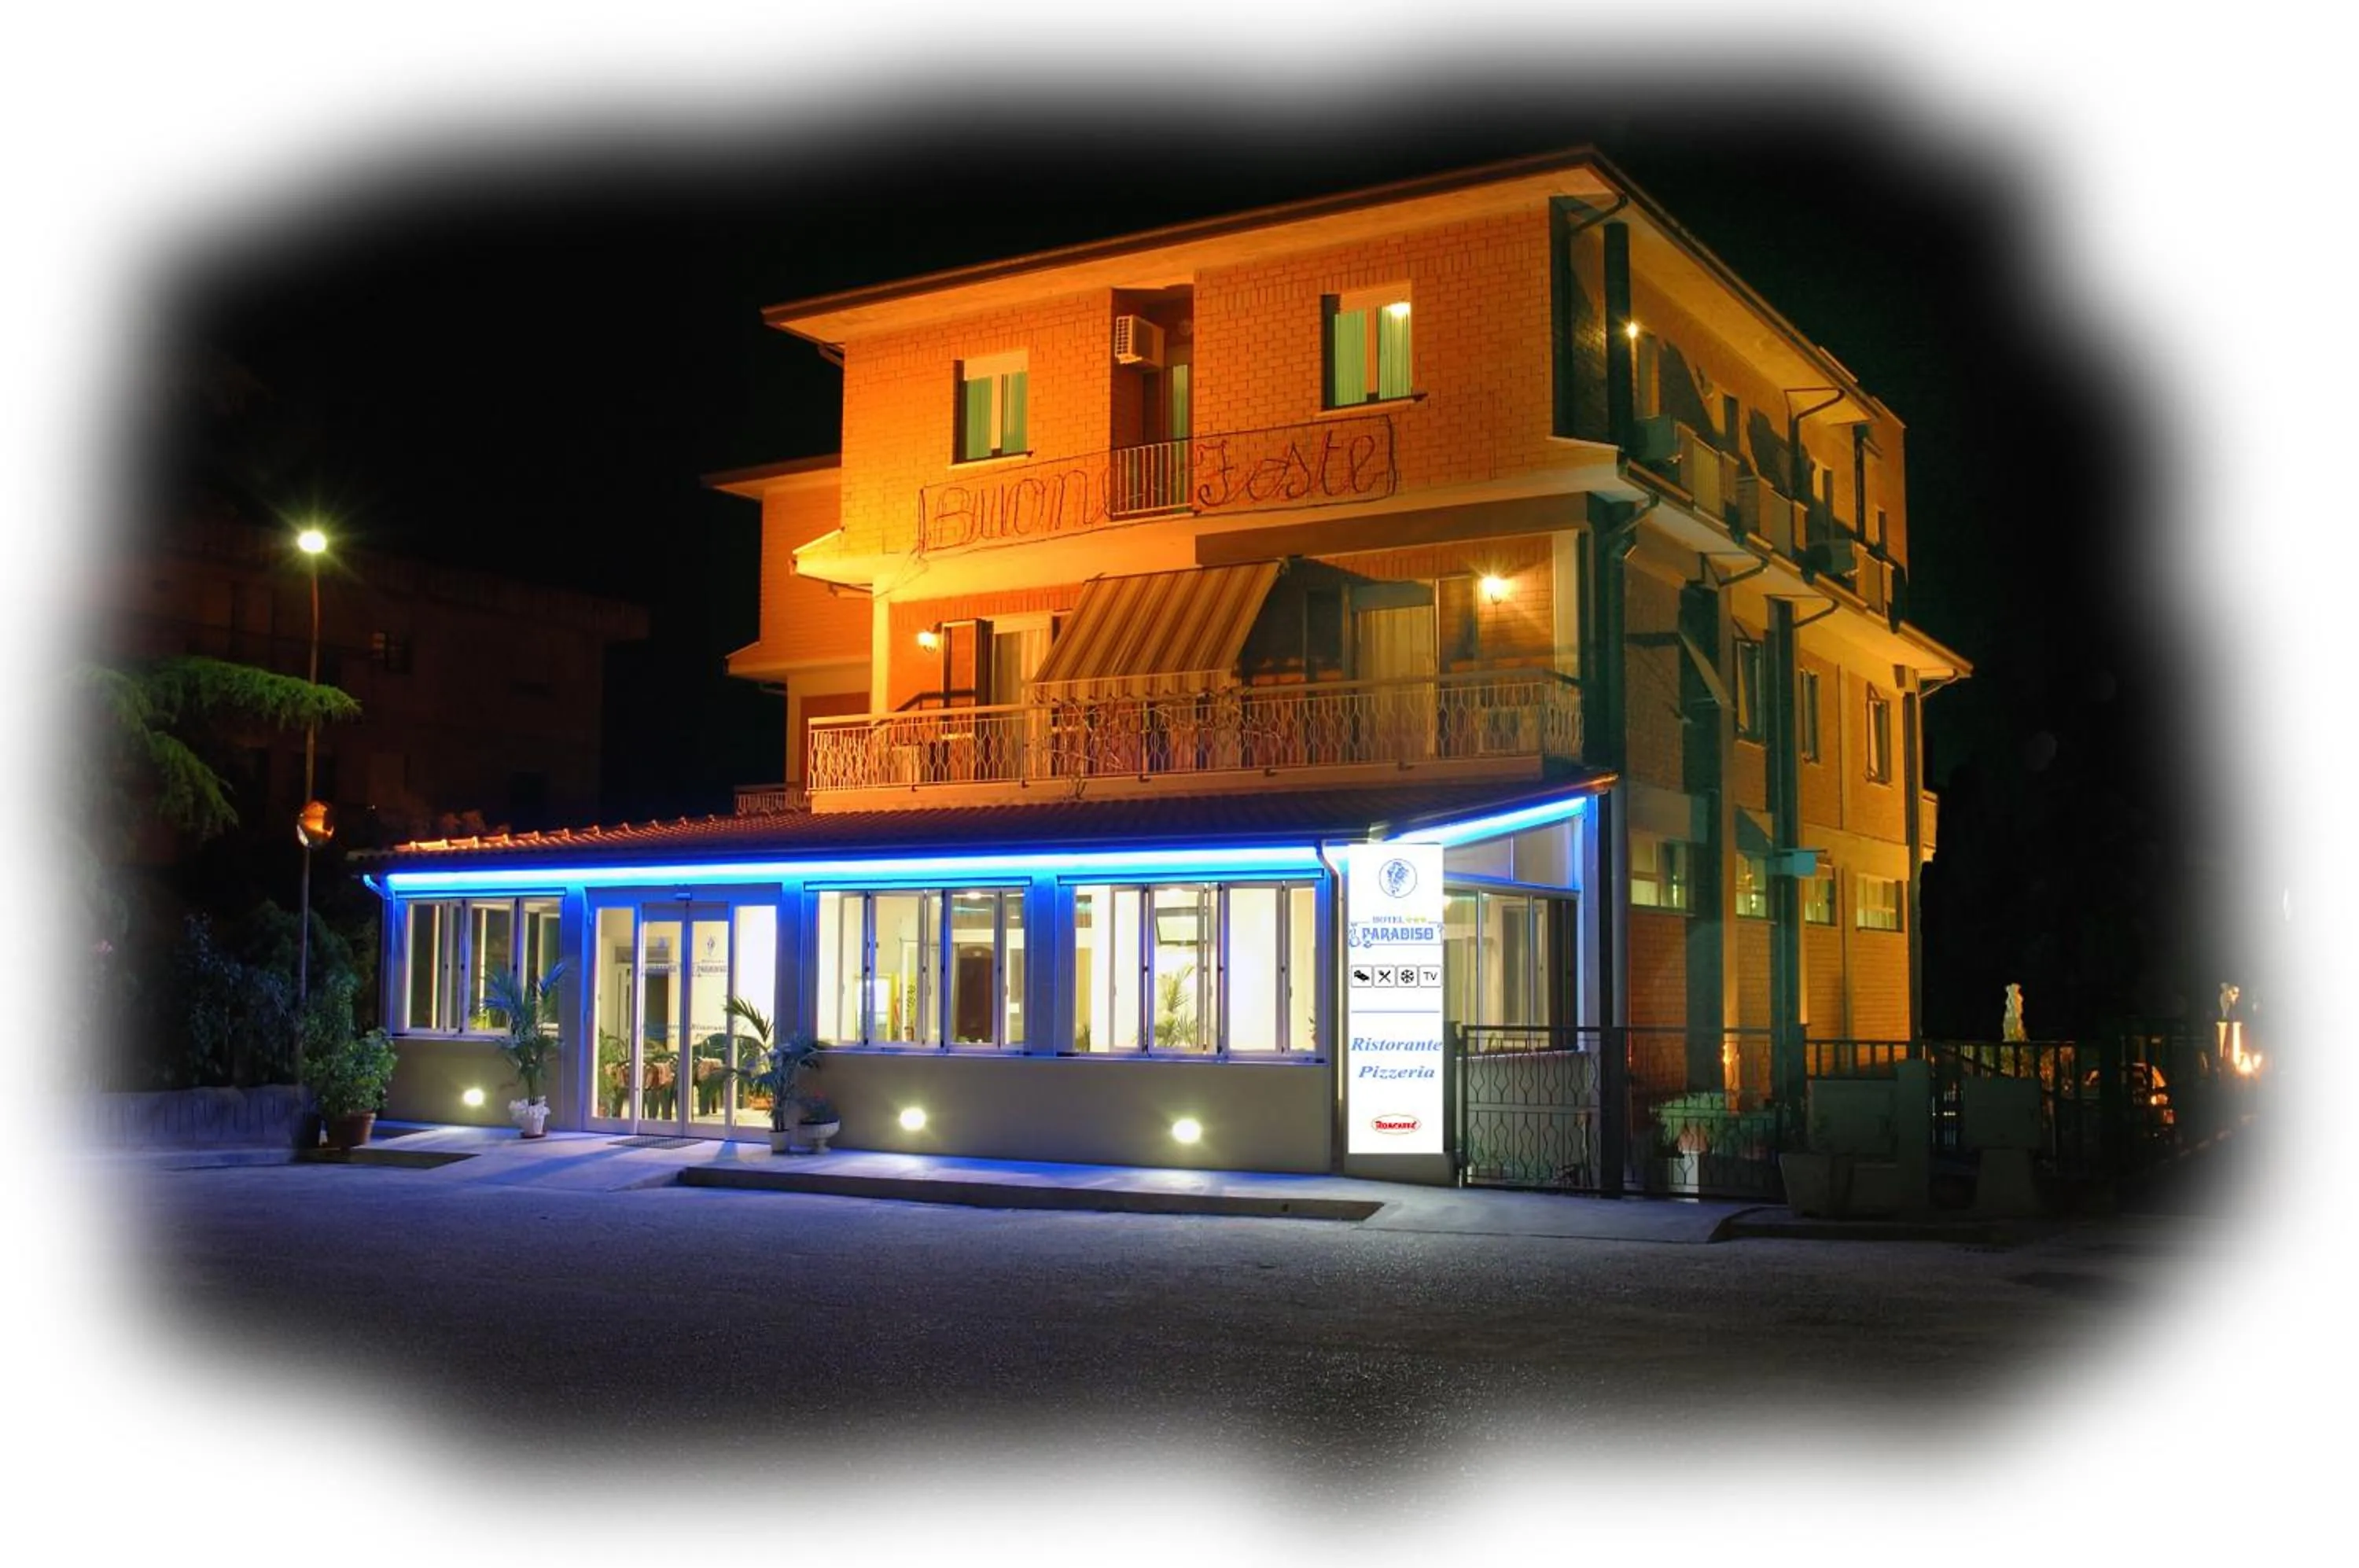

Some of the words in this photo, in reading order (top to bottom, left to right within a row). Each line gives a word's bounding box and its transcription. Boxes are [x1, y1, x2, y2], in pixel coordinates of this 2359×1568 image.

[1362, 927, 1433, 941] PARADISO
[1423, 972, 1437, 981] TV
[1351, 1037, 1443, 1051] Ristorante
[1359, 1066, 1435, 1080] Pizzeria
